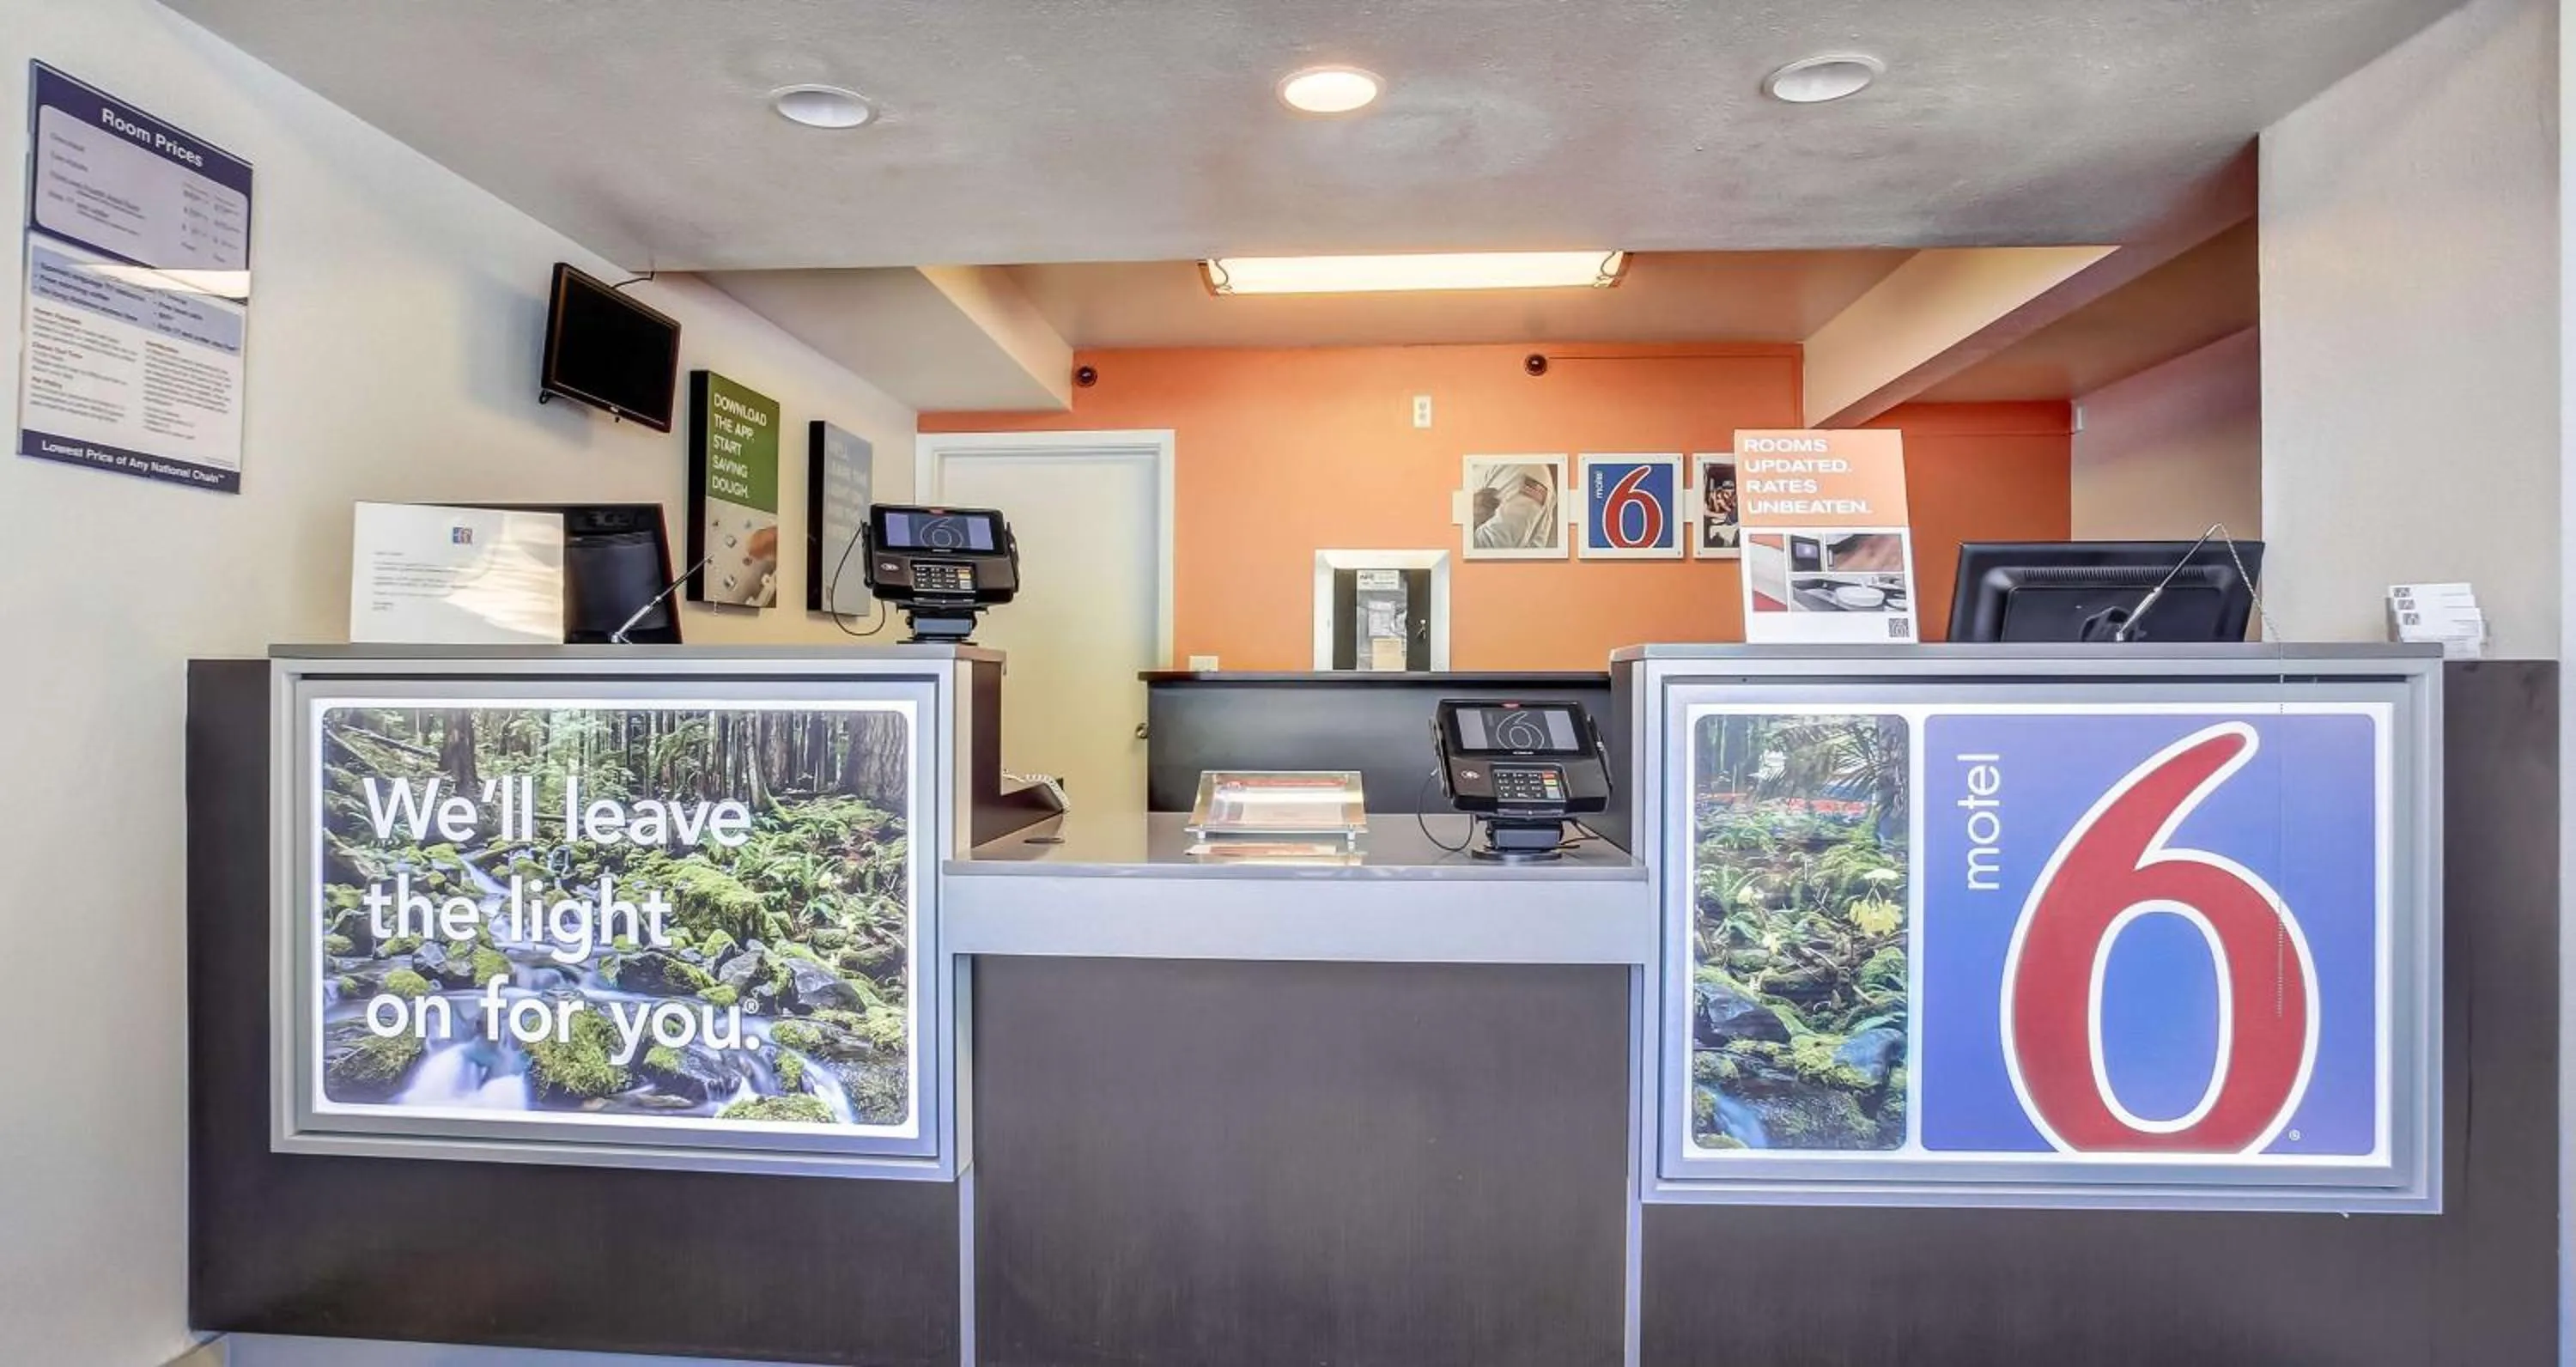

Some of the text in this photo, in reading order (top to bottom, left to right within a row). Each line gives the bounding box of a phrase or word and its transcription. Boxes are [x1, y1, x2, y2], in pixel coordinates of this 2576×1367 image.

[102, 107, 150, 144] Room
[155, 132, 204, 167] Prices
[714, 392, 767, 426] DOWNLOAD
[714, 413, 733, 433] THE
[42, 440, 83, 457] Lowest
[87, 449, 113, 464] Price
[116, 456, 127, 465] of
[129, 457, 149, 471] Any
[150, 461, 191, 478] National
[714, 434, 742, 456] START
[1744, 438, 1828, 453] ROOMS
[713, 454, 748, 477] SAVING
[1745, 459, 1852, 473] UPDATED.
[1746, 479, 1818, 494] RATES
[1602, 465, 1663, 549] 6
[1747, 499, 1873, 514] UNBEATEN.
[1496, 711, 1545, 749] 6
[363, 775, 751, 847] We'll leave
[1957, 753, 2000, 890] motel
[363, 872, 671, 963] the light
[2000, 720, 2319, 1154] 6
[366, 992, 451, 1038] on
[481, 974, 585, 1042] for
